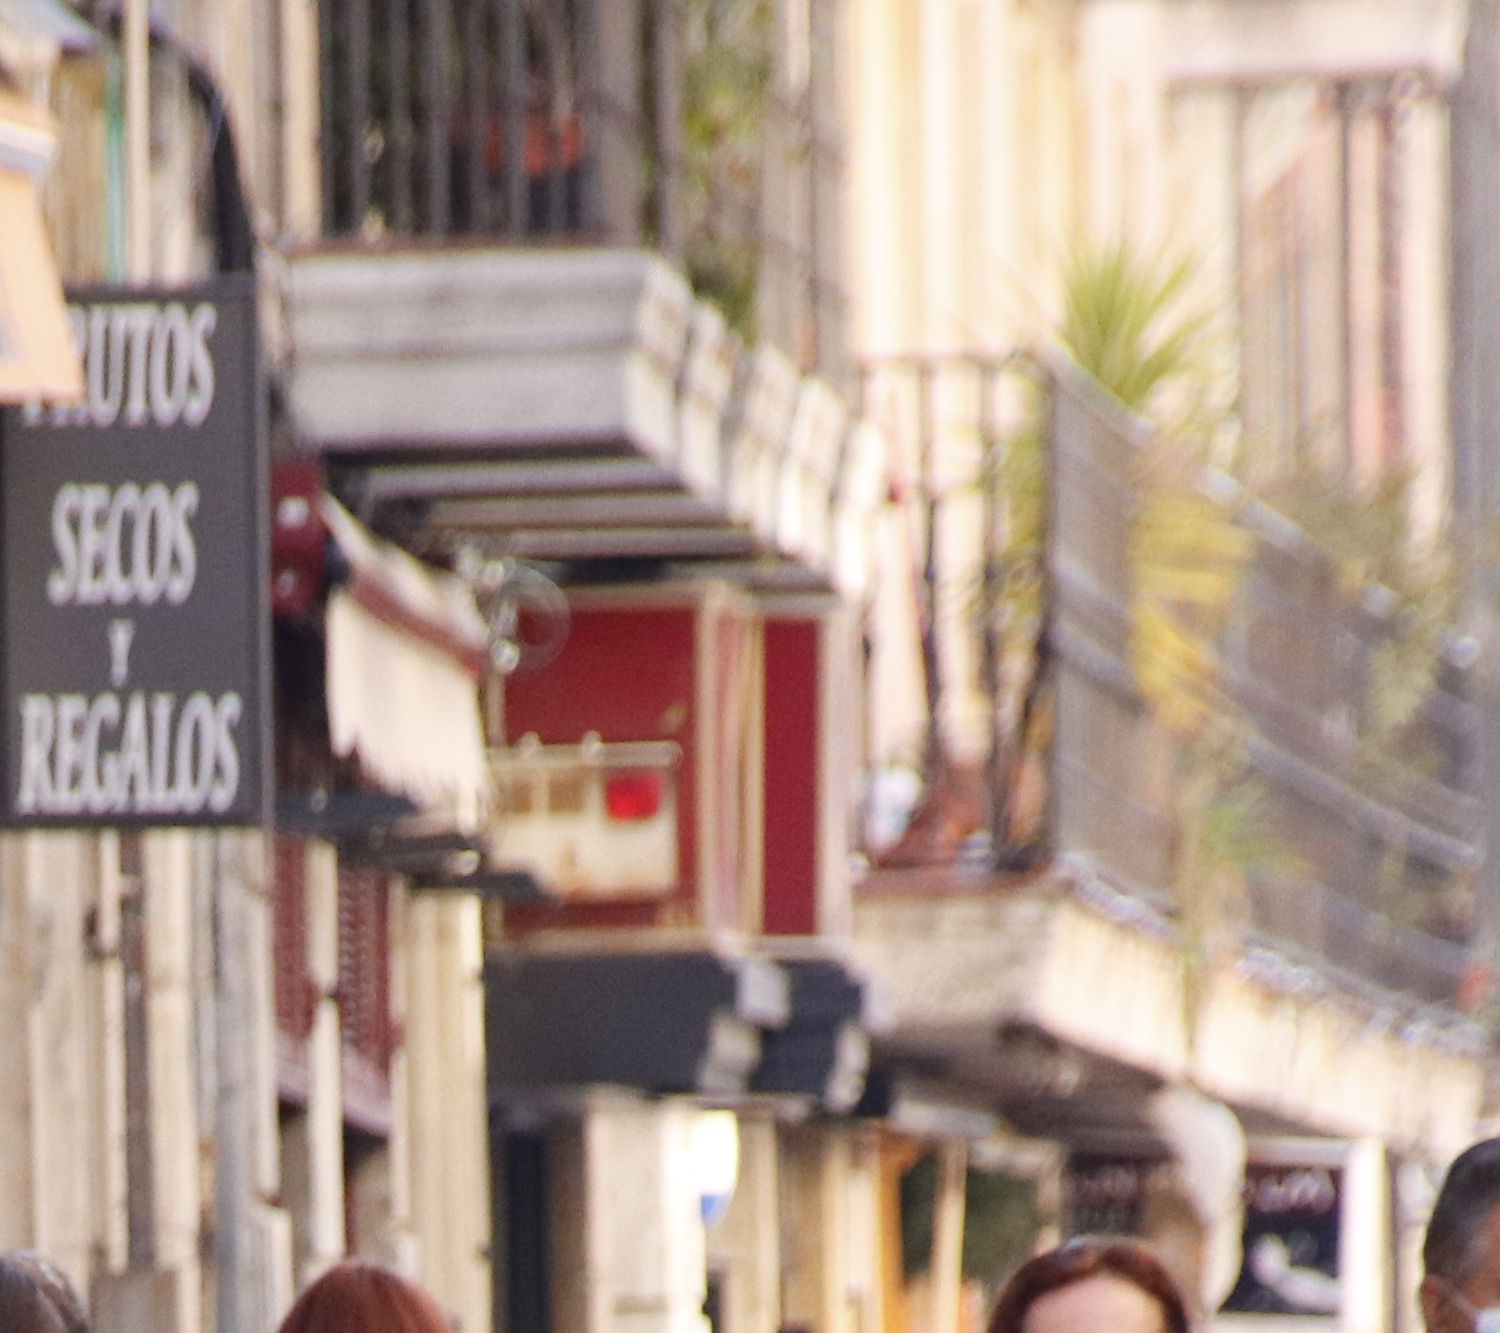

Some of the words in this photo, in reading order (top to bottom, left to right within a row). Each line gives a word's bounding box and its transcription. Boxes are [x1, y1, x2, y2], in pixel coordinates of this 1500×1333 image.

[21, 302, 217, 428] UTOS
[47, 480, 200, 606] SECOS
[107, 617, 136, 688] Y
[16, 690, 243, 816] REGALOS
